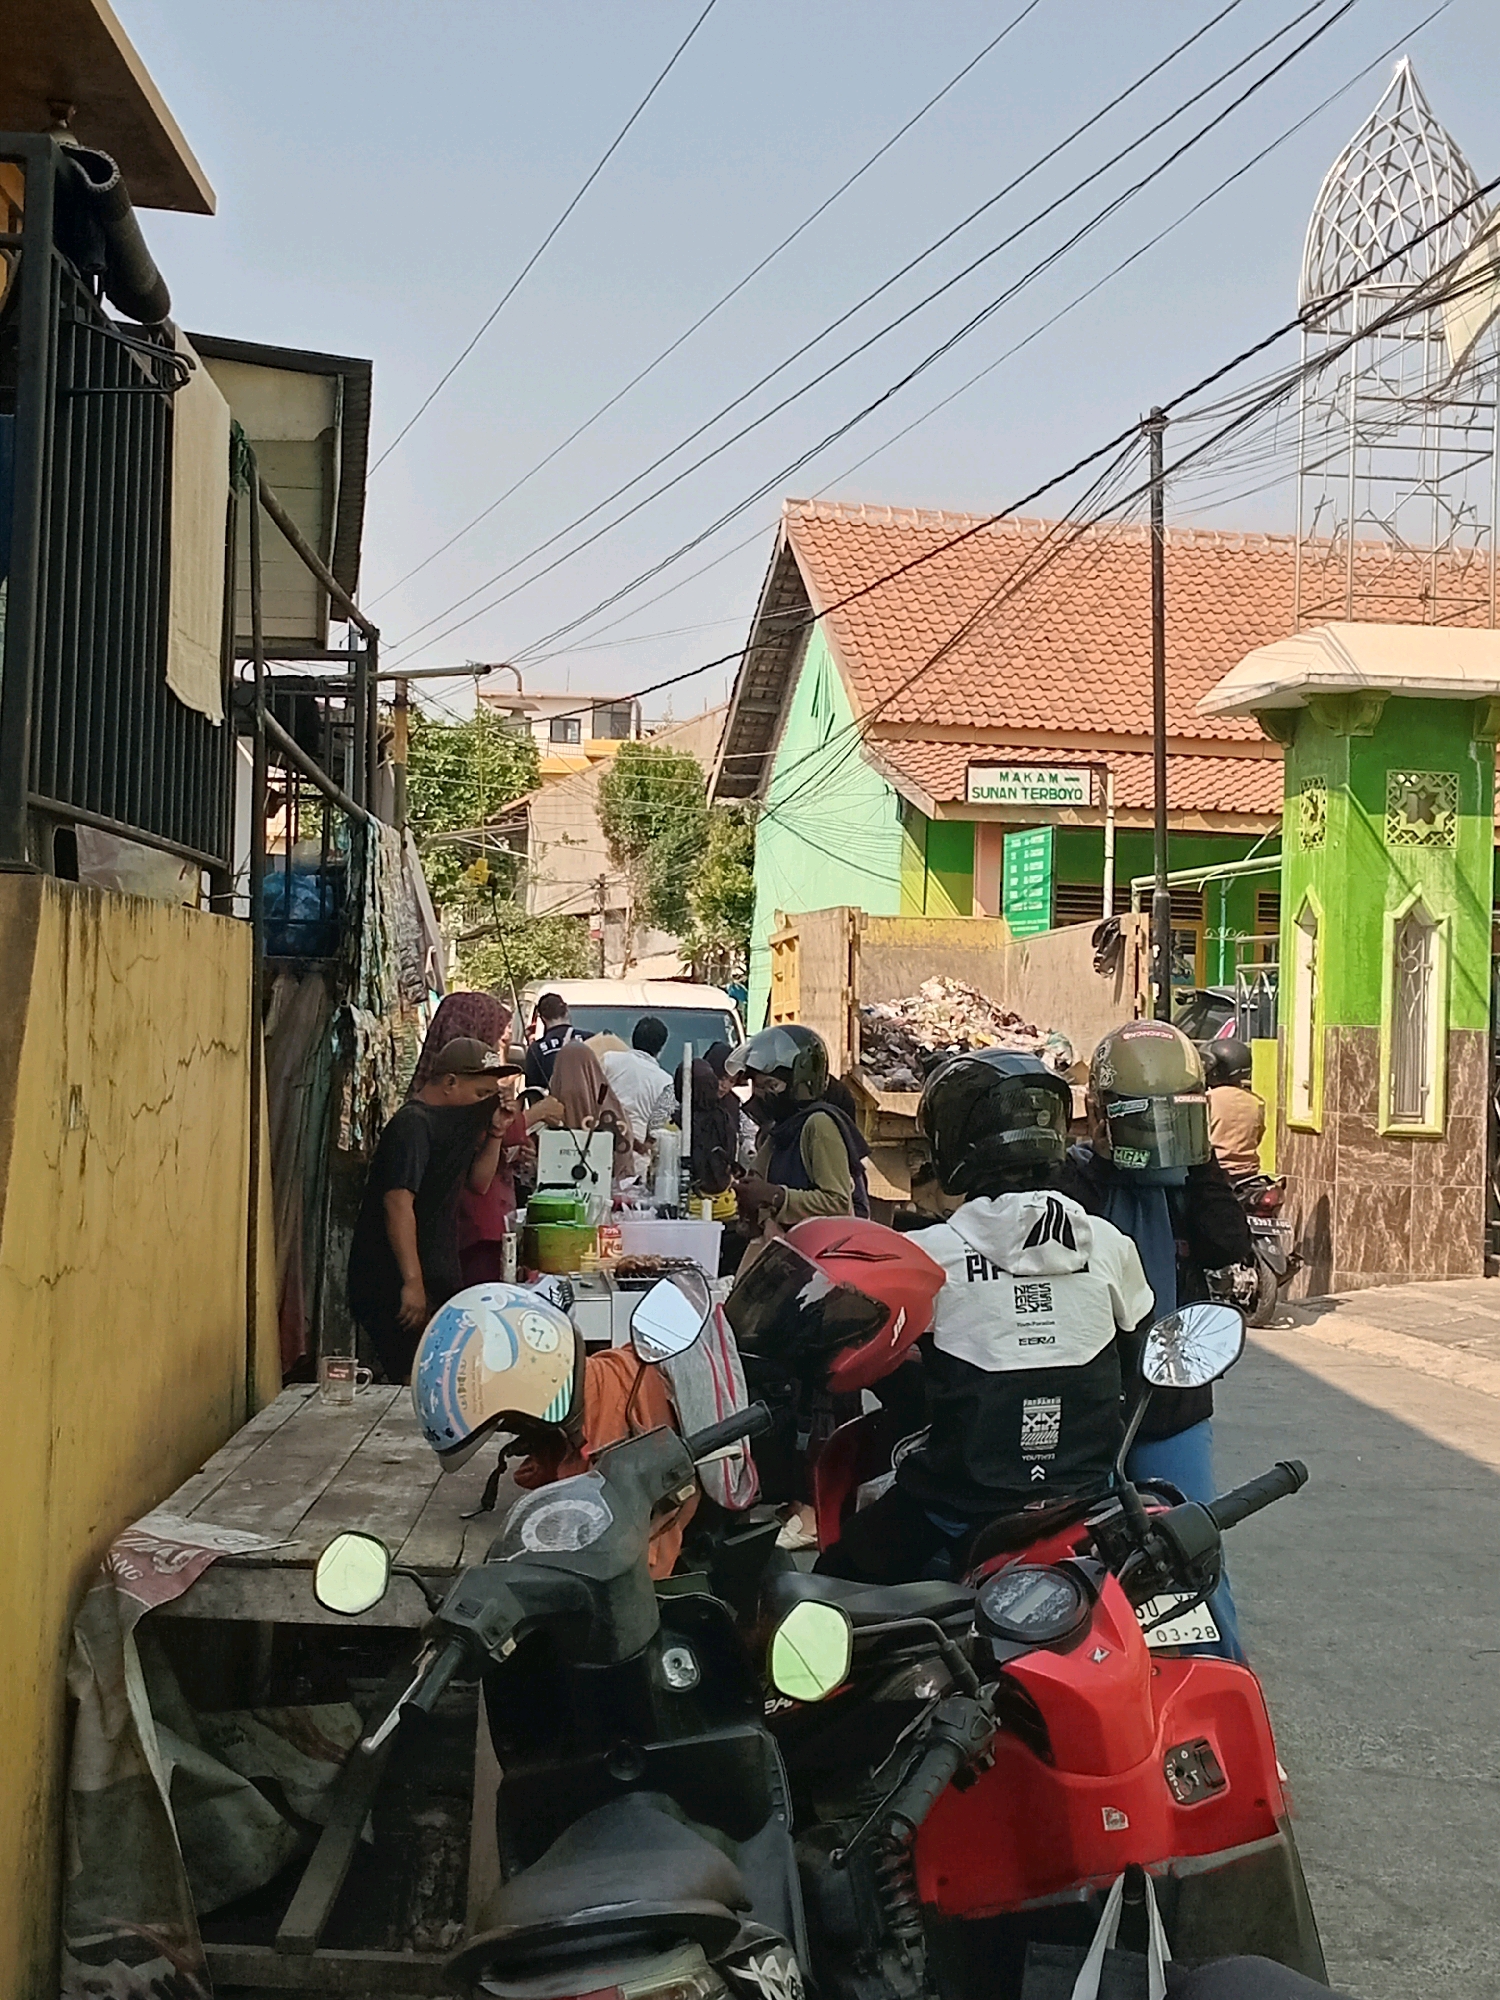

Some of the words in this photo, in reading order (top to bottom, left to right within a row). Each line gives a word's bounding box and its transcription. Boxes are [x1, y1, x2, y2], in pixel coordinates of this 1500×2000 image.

[1000, 771, 1058, 784] MAKAM
[971, 787, 1017, 800] SUNAN
[1021, 787, 1083, 800] TERBOYO
